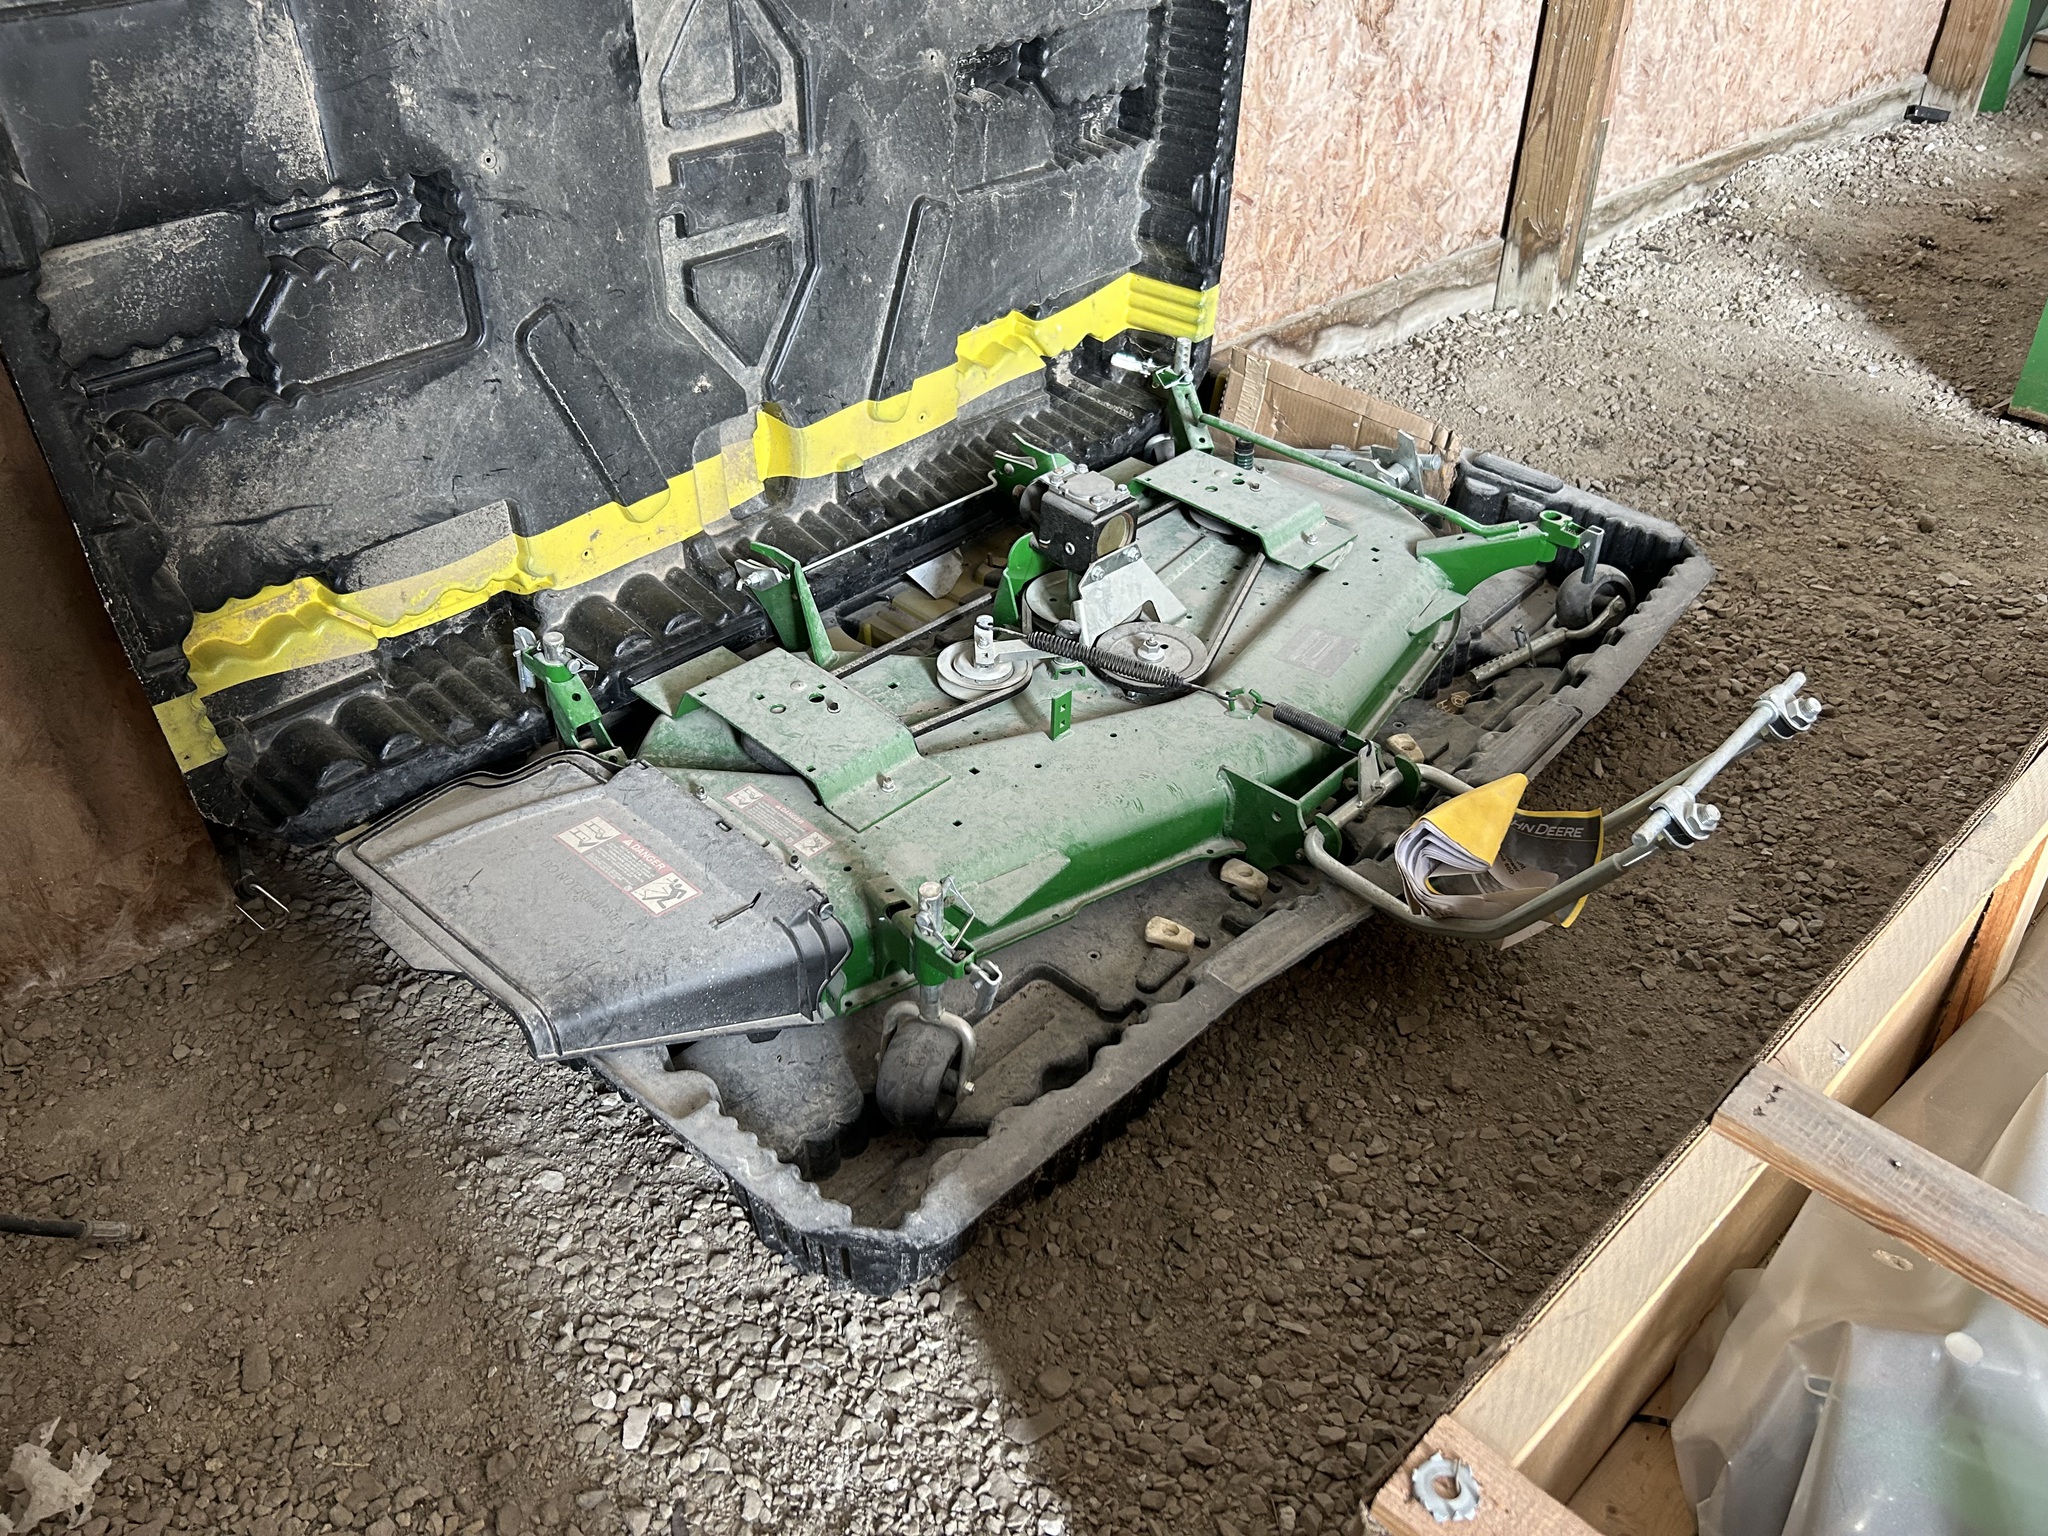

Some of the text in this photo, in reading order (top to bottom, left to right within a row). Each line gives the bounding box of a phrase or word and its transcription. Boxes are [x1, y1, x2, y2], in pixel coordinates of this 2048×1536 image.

[780, 806, 805, 824] DANGER
[1510, 820, 1584, 838] HN DEERE
[631, 843, 666, 871] DANGER
[540, 859, 623, 926] DO NOT REMOVE
